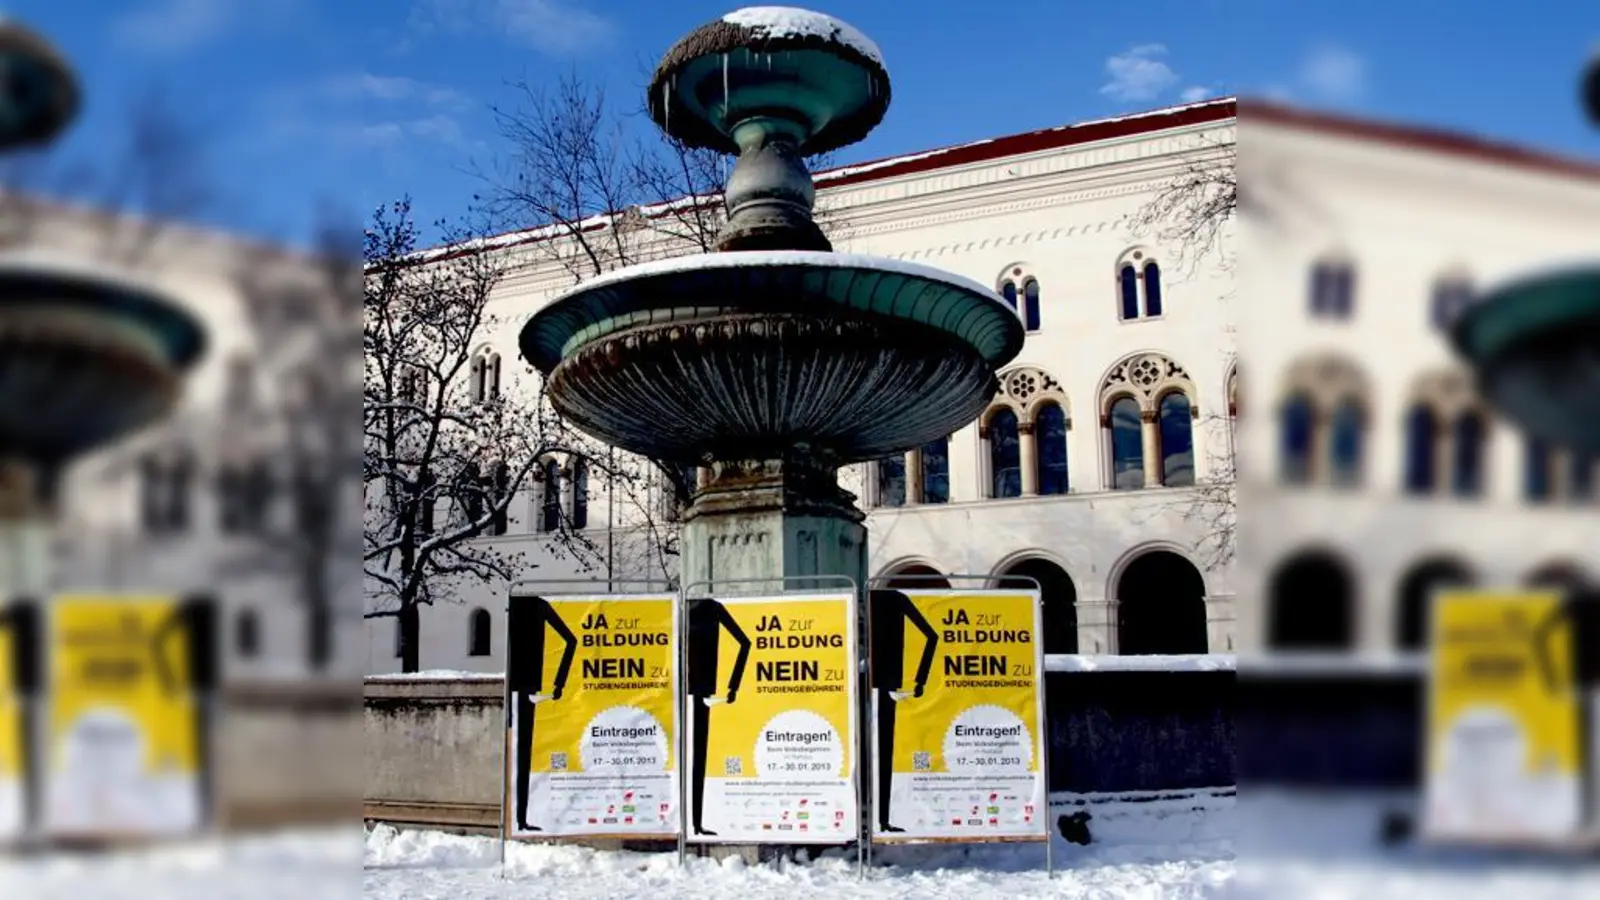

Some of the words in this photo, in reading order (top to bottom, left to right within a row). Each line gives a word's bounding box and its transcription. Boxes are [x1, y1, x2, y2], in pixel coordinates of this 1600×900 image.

[582, 614, 608, 630] JA
[615, 617, 640, 630] zur
[756, 615, 782, 632] JA
[789, 619, 815, 631] zur
[942, 609, 970, 625] JA
[976, 614, 1001, 626] zur
[583, 633, 669, 647] BILDUNG
[756, 634, 843, 649] BILDUNG
[943, 630, 1031, 643] BILDUNG
[583, 658, 645, 678] NEIN
[650, 667, 669, 678] zu
[756, 660, 819, 681] NEIN
[824, 669, 845, 681] zu
[944, 655, 1007, 676] NEIN
[1013, 664, 1032, 676] zu
[756, 684, 845, 693] STUDIENGEBÜHREN!
[591, 725, 657, 738] Eintragen!
[766, 730, 832, 744] Eintragen!
[955, 725, 1021, 738] Eintragen!
